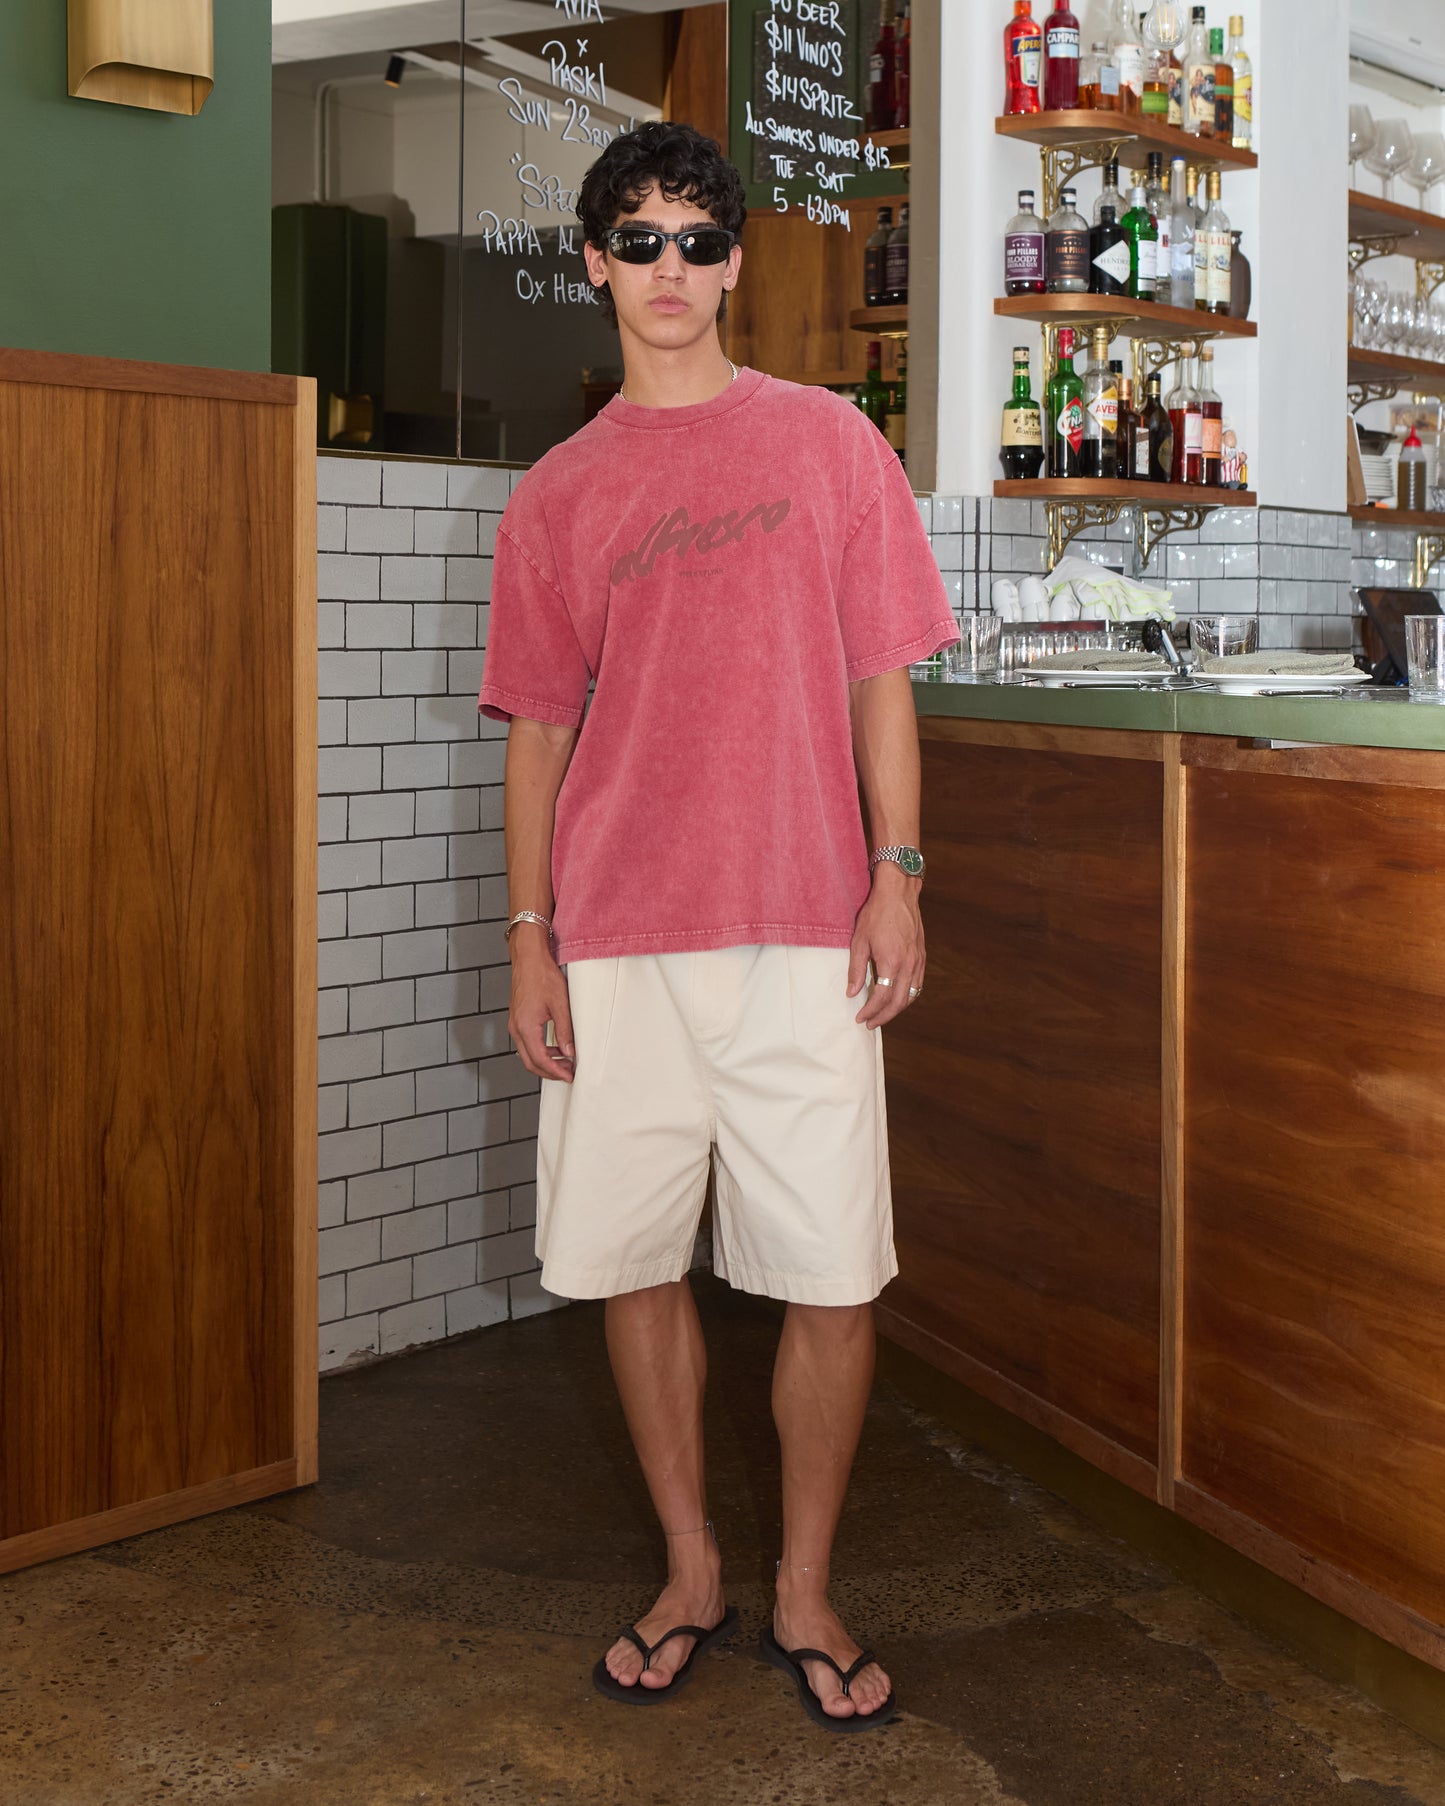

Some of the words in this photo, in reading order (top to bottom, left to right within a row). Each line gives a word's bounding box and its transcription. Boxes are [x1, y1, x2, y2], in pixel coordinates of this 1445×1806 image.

[797, 0, 846, 36] BEER
[764, 14, 792, 58] $11
[796, 27, 843, 77] VINO'S
[1047, 32, 1079, 44] CAMPAR
[765, 62, 798, 103] $14
[800, 77, 863, 120] SPRITZ
[765, 117, 816, 153] SNACKS
[819, 131, 860, 160] UNDER
[864, 137, 890, 171] $15
[769, 154, 798, 179] TUE
[773, 186, 788, 212] 5
[477, 210, 543, 256] PAPPA
[554, 272, 600, 306] HEAR
